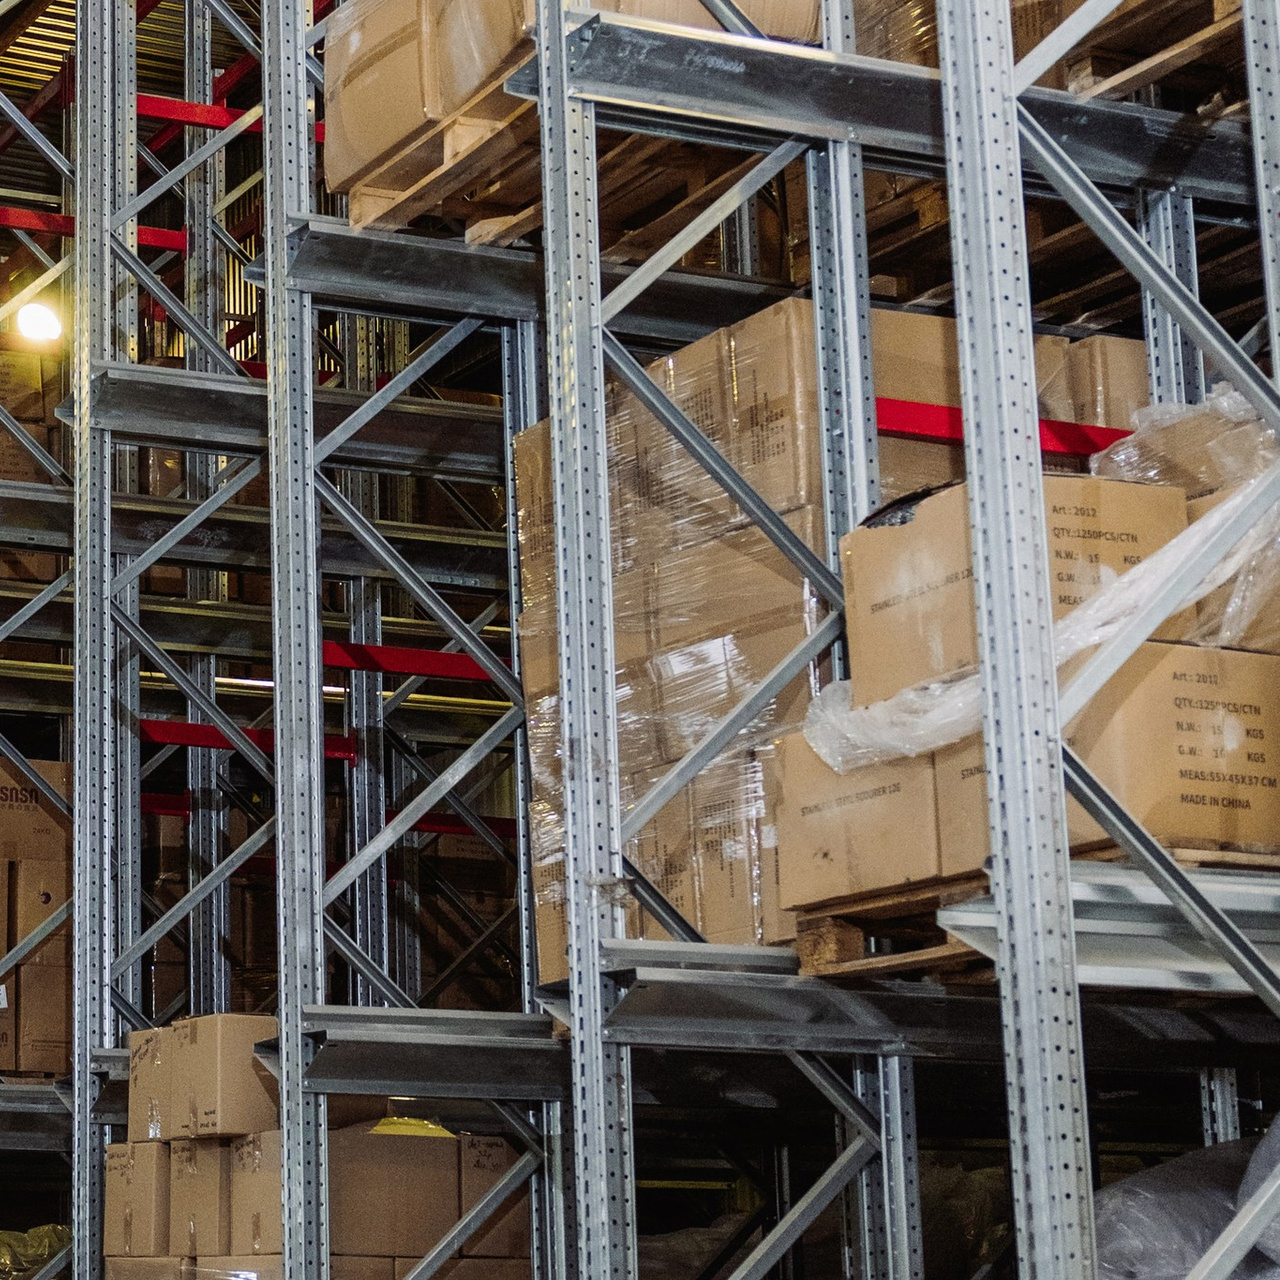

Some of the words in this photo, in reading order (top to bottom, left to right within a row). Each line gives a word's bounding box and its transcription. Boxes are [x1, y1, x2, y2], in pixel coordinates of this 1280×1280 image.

[1074, 506, 1097, 518] 2012
[1246, 728, 1265, 740] KGS
[1247, 752, 1266, 764] KGS
[1181, 793, 1207, 807] MADE
[1210, 796, 1220, 807] IN
[1221, 796, 1252, 811] CHINA
